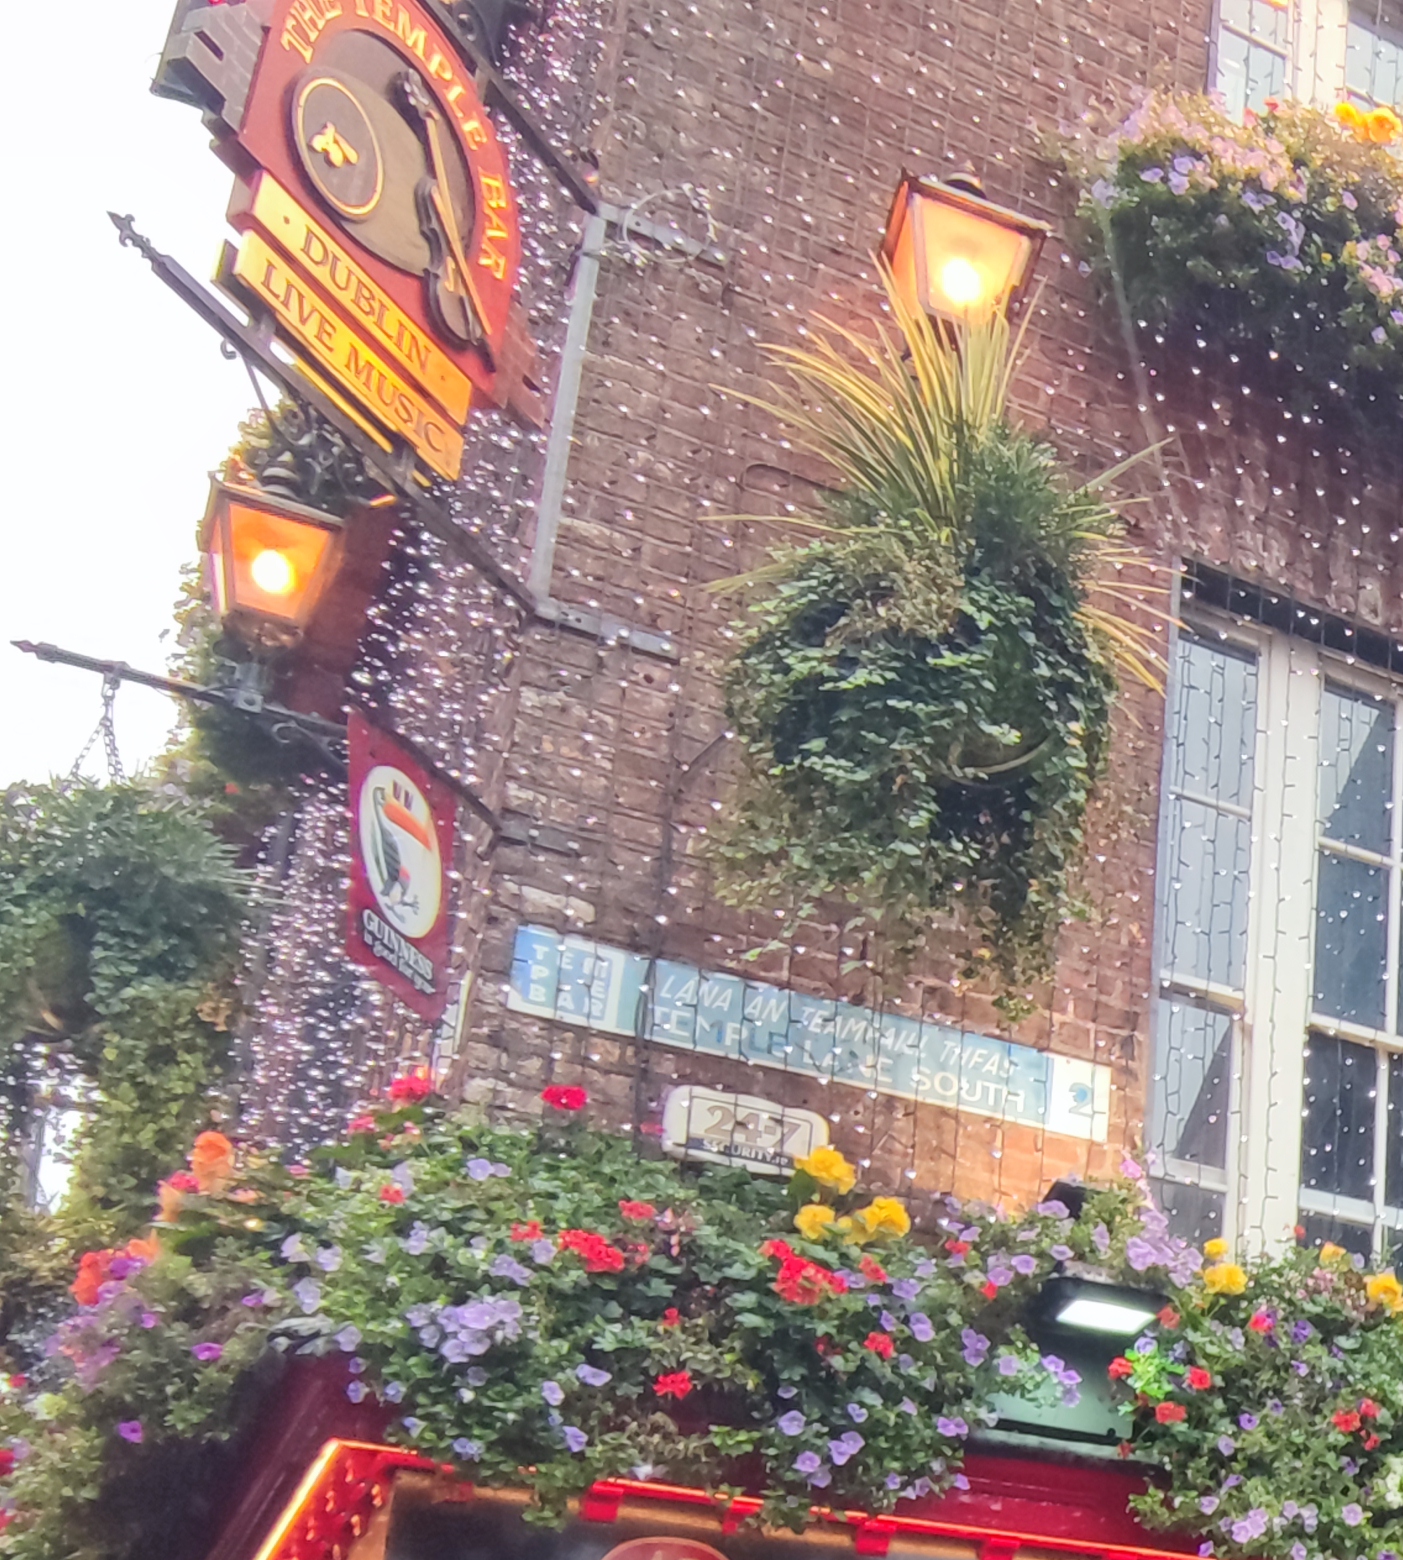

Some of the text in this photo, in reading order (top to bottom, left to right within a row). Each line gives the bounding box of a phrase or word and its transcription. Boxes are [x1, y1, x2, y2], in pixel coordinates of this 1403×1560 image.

[476, 166, 509, 281] BAR
[300, 224, 432, 373] DUBLIN
[260, 258, 446, 453] LIVE MUSIC
[363, 909, 434, 979] GUINNESS
[745, 995, 788, 1022] AN
[909, 1065, 1025, 1113] SOUTH
[704, 1105, 801, 1148] 24-7
